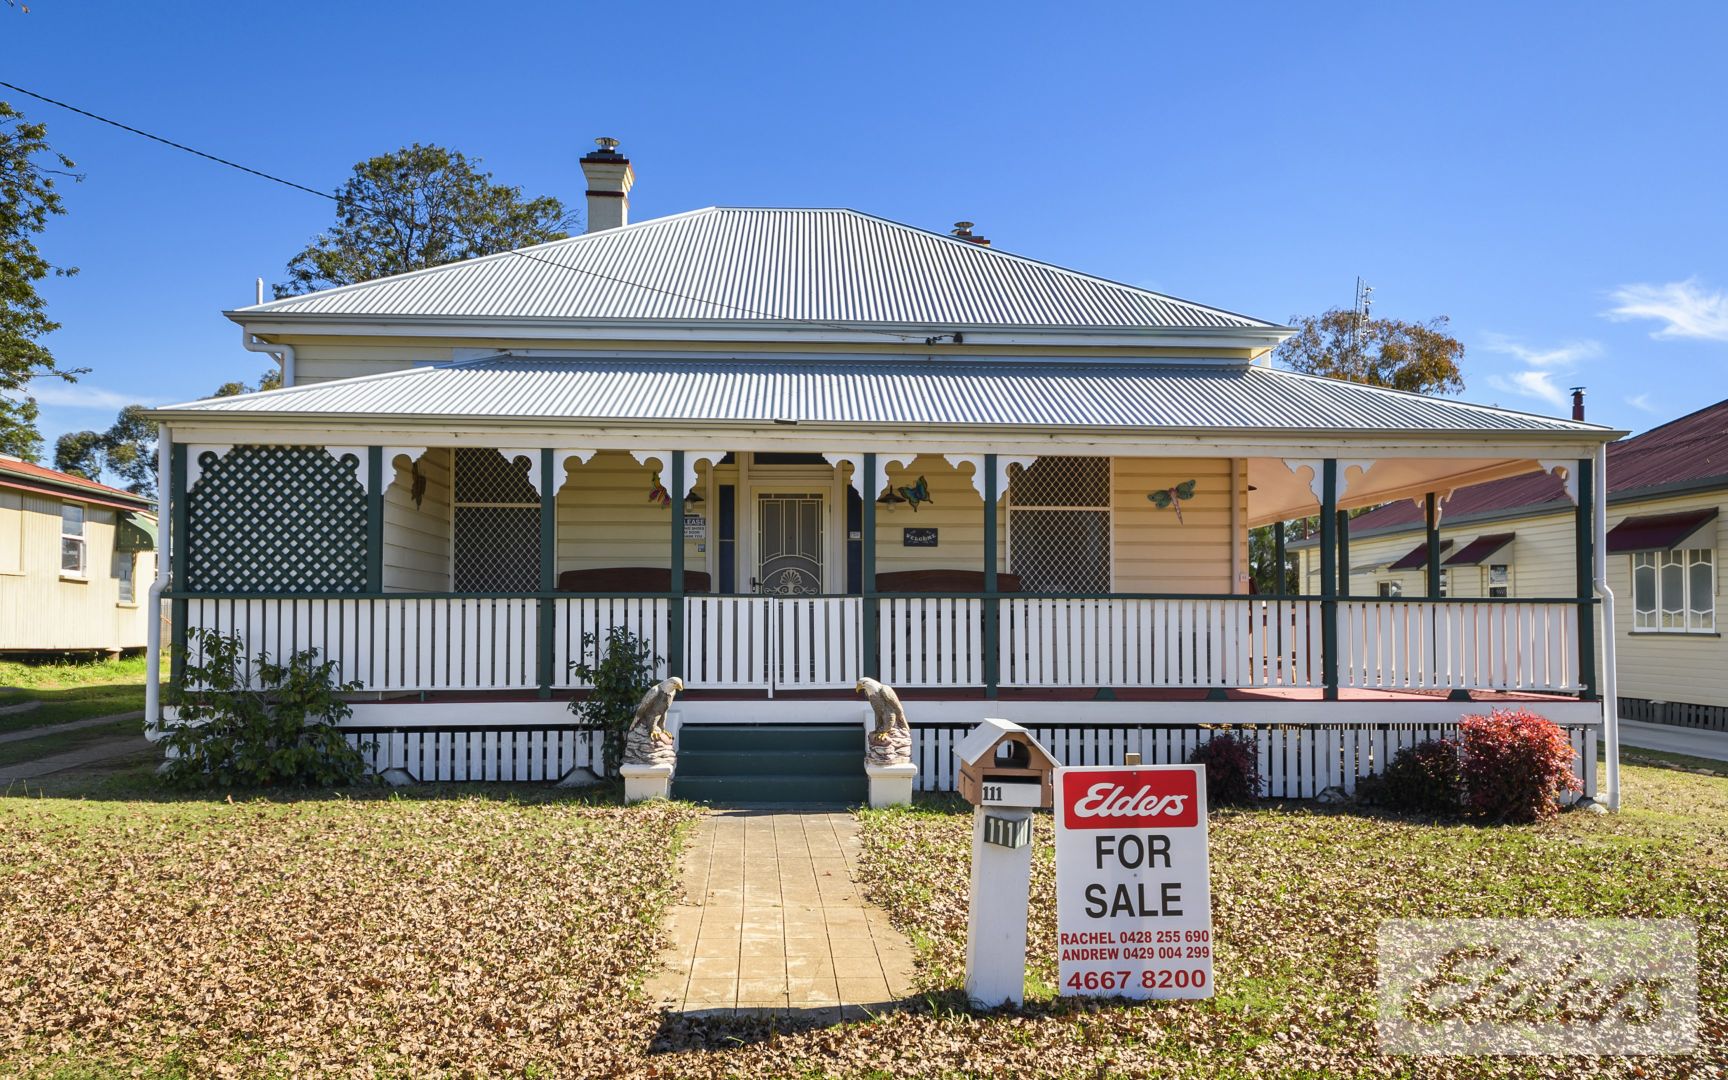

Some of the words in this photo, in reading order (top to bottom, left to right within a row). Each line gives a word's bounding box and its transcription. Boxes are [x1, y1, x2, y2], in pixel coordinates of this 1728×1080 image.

[982, 786, 1002, 801] 111
[1074, 783, 1188, 818] Elders
[988, 818, 1013, 848] 111
[1095, 834, 1171, 869] FOR
[1085, 882, 1183, 918] SALE
[1061, 932, 1116, 945] RACHEL
[1120, 931, 1152, 944] 0428
[1156, 931, 1181, 943] 255
[1185, 930, 1209, 943] 690
[1062, 948, 1119, 961] ANDREW
[1123, 947, 1155, 960] 0429
[1158, 947, 1182, 959] 004
[1186, 946, 1209, 959] 299
[1067, 970, 1132, 990] 4667
[1142, 969, 1206, 988] 8200
